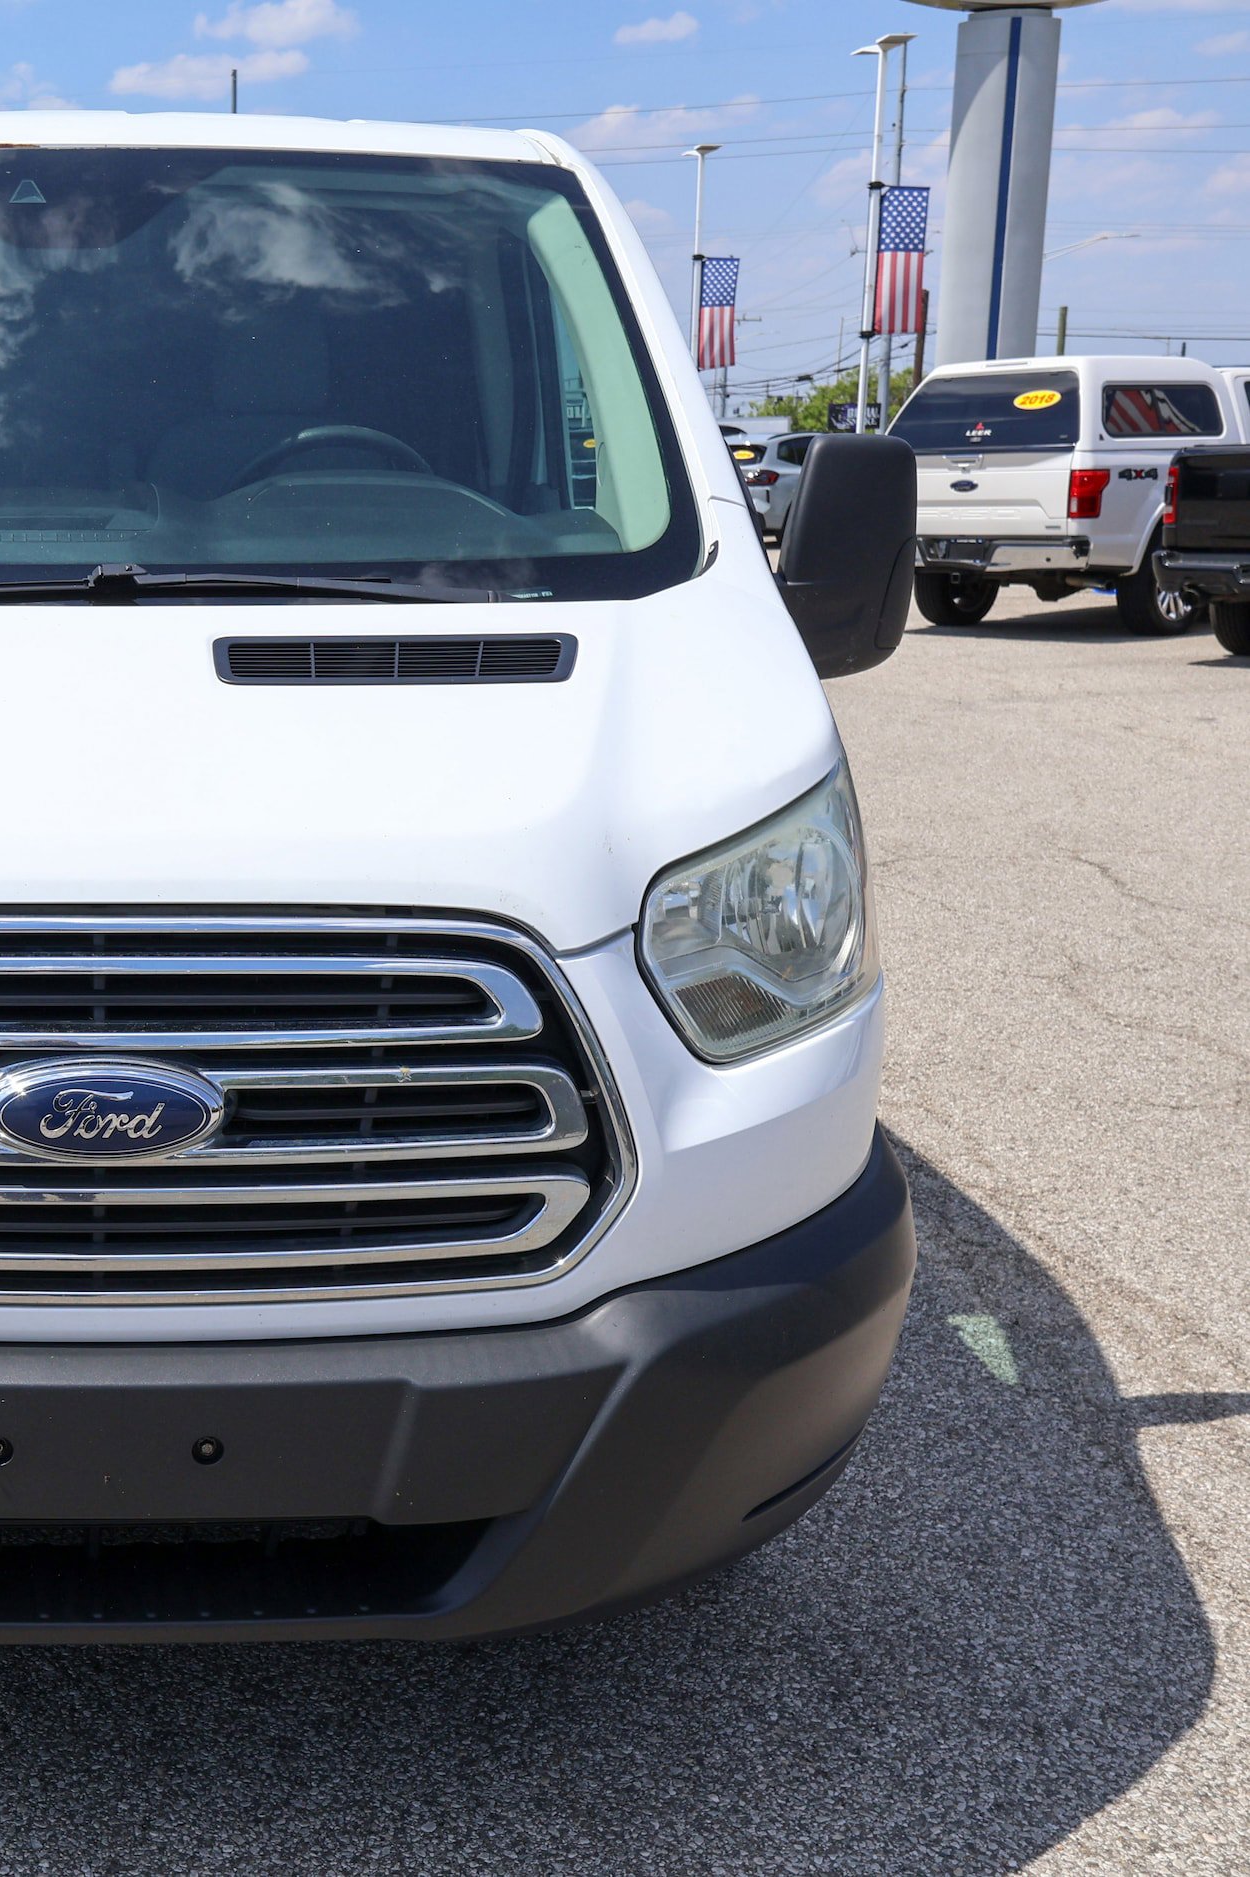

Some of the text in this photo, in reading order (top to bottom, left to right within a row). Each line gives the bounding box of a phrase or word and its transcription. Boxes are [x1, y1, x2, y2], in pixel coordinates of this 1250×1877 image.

[1017, 393, 1057, 406] 2018
[965, 429, 992, 437] LEER
[40, 1088, 166, 1139] Ford
